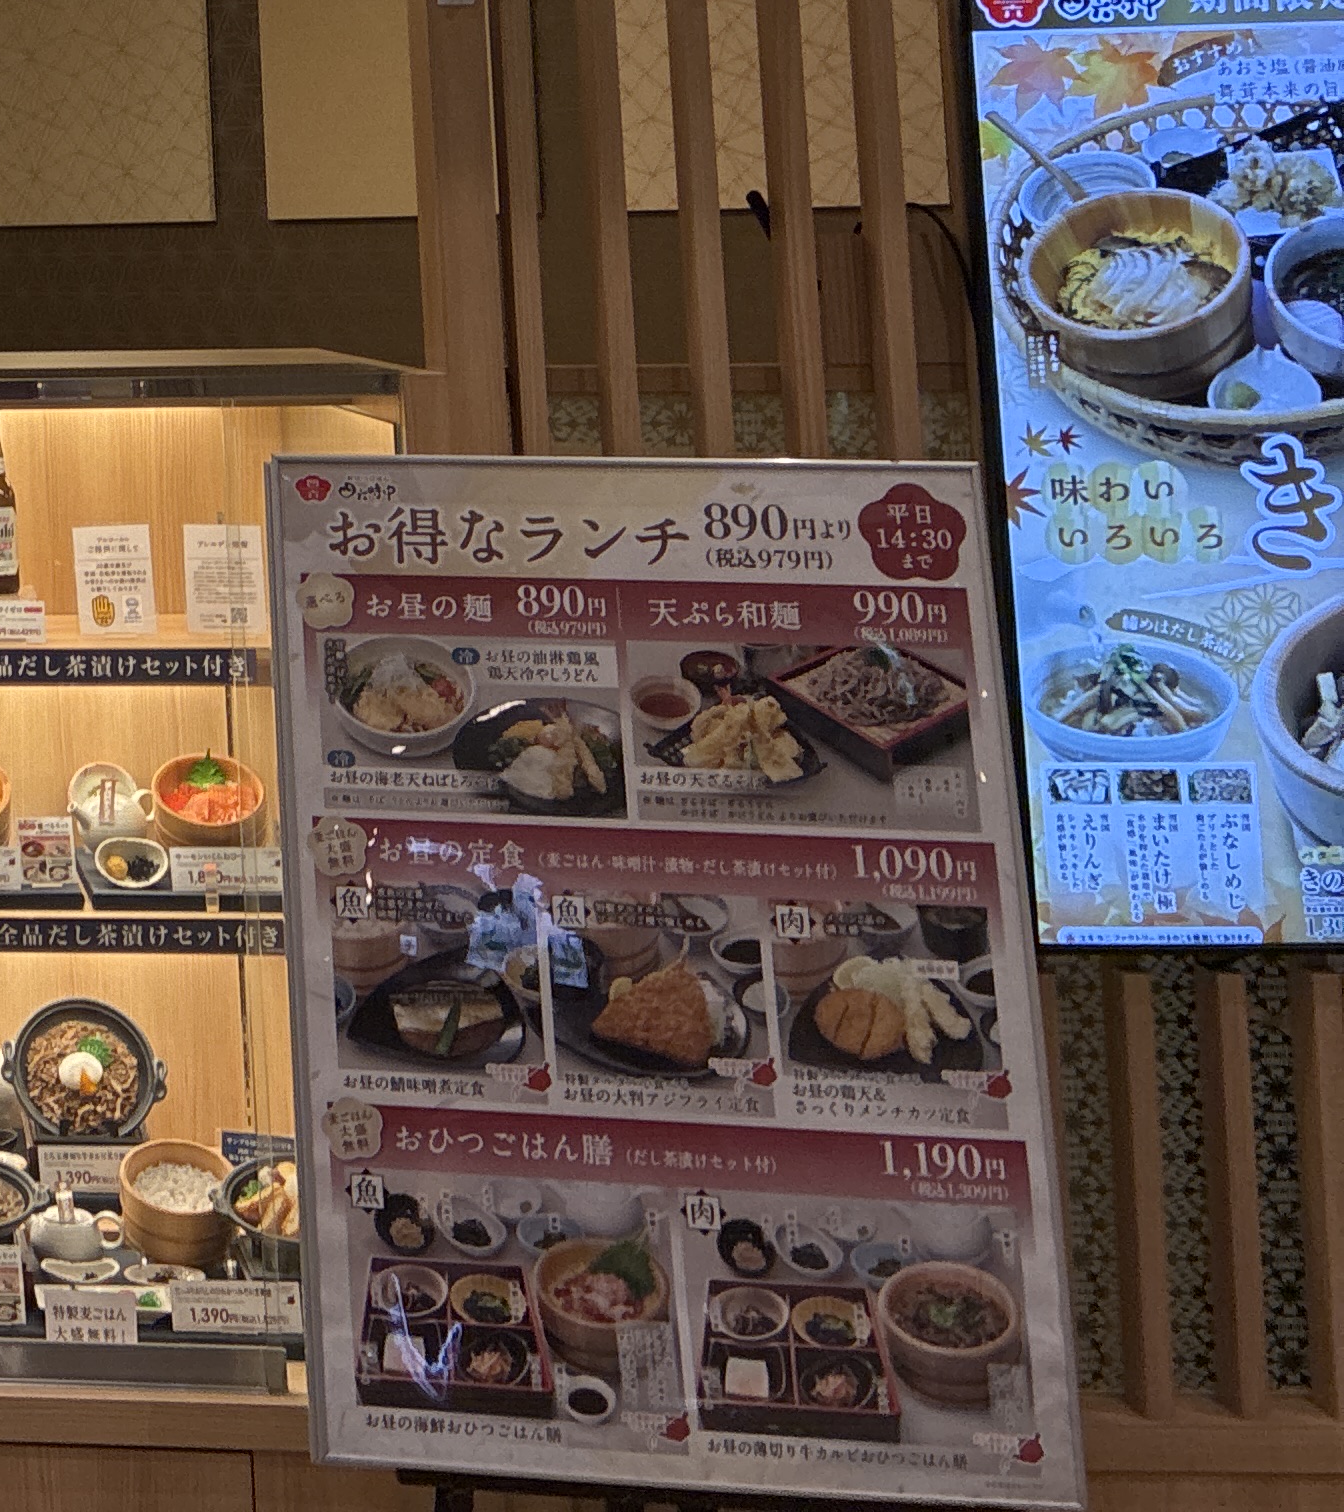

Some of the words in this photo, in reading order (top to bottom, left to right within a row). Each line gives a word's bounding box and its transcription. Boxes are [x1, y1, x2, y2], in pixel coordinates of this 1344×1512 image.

[1050, 475, 1175, 506] 味わい
[886, 503, 932, 525] 平日
[328, 506, 690, 566] お得なランチ
[703, 502, 852, 541] 890円より
[876, 528, 953, 551] 14:30
[1057, 524, 1225, 551] いろいろ
[705, 548, 833, 571] (税込979円)
[900, 554, 933, 570] まで
[366, 593, 493, 622] お昼の麺
[516, 584, 607, 619] 890円
[647, 598, 802, 631] 天ぷら和麺
[853, 590, 948, 626] 990円
[851, 843, 978, 884] 1,090円
[1083, 813, 1102, 892] えりんぎ
[1220, 813, 1247, 912] ぶなしめじ
[338, 886, 366, 917] 魚
[555, 895, 584, 926] 魚
[780, 909, 806, 935] 肉
[395, 1124, 614, 1167] おひつごはん膳
[878, 1140, 1007, 1181] 1,190円
[354, 1177, 382, 1206] 魚
[692, 1199, 716, 1225] 肉
[52, 1304, 127, 1322] 特製麦ごはん
